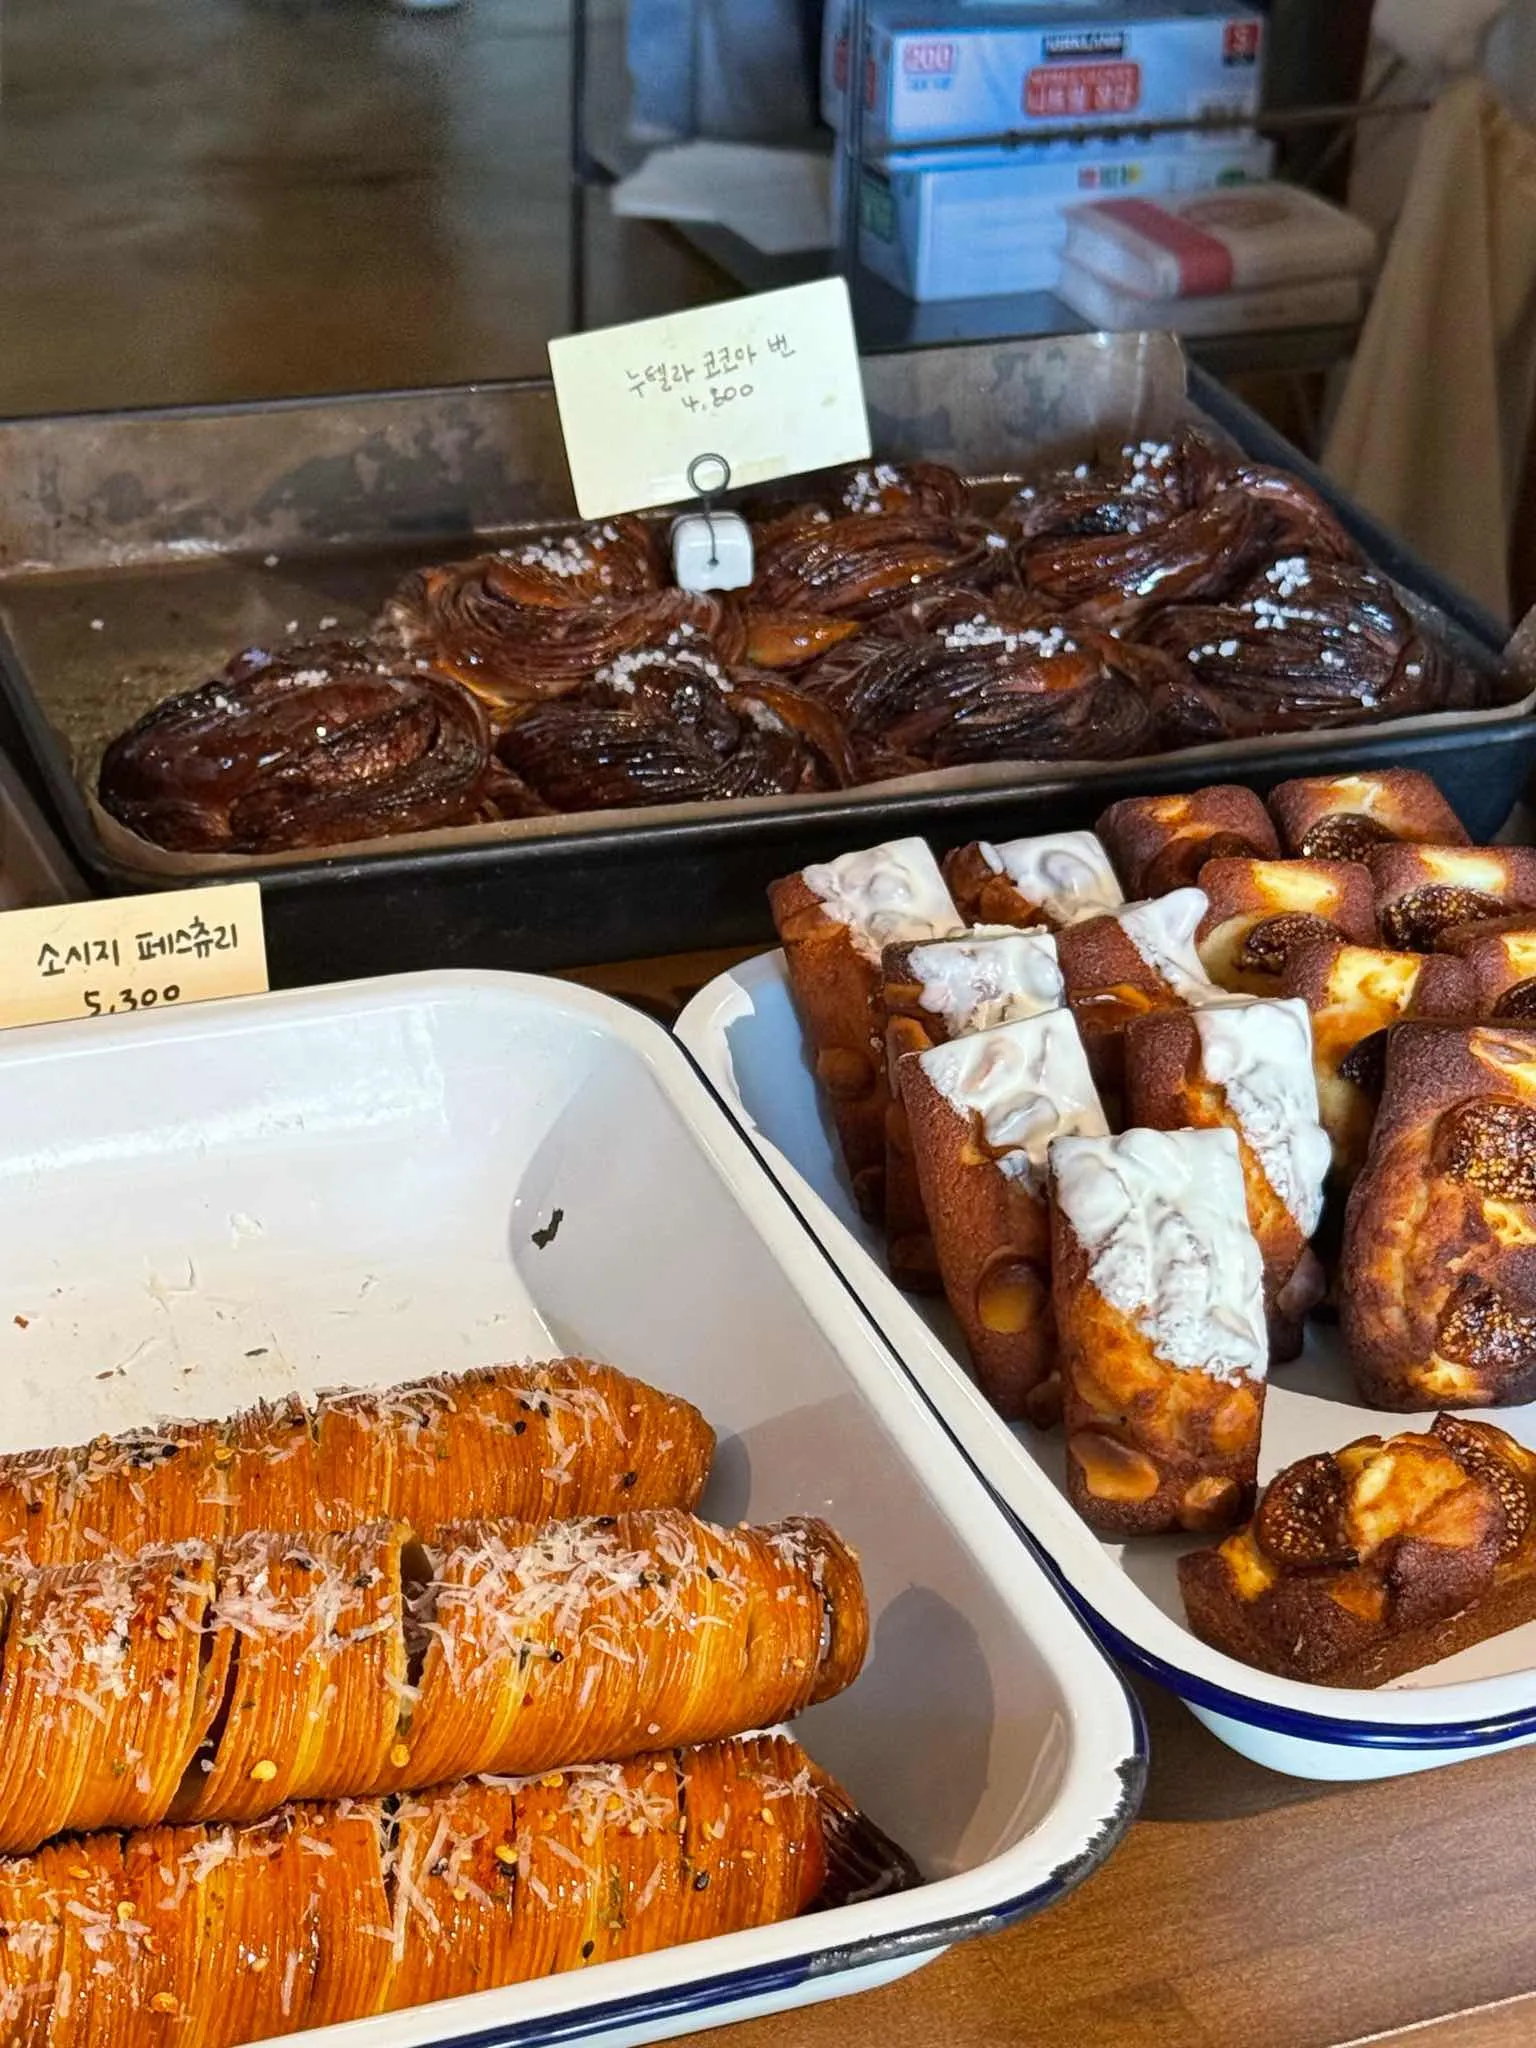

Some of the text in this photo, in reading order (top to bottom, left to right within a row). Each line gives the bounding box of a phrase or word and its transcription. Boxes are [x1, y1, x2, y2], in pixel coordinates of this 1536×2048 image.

[626, 334, 797, 398] 누텔라 코코아 번
[37, 915, 238, 977] 소시지 페스츄리
[84, 984, 181, 1016] 5,300
